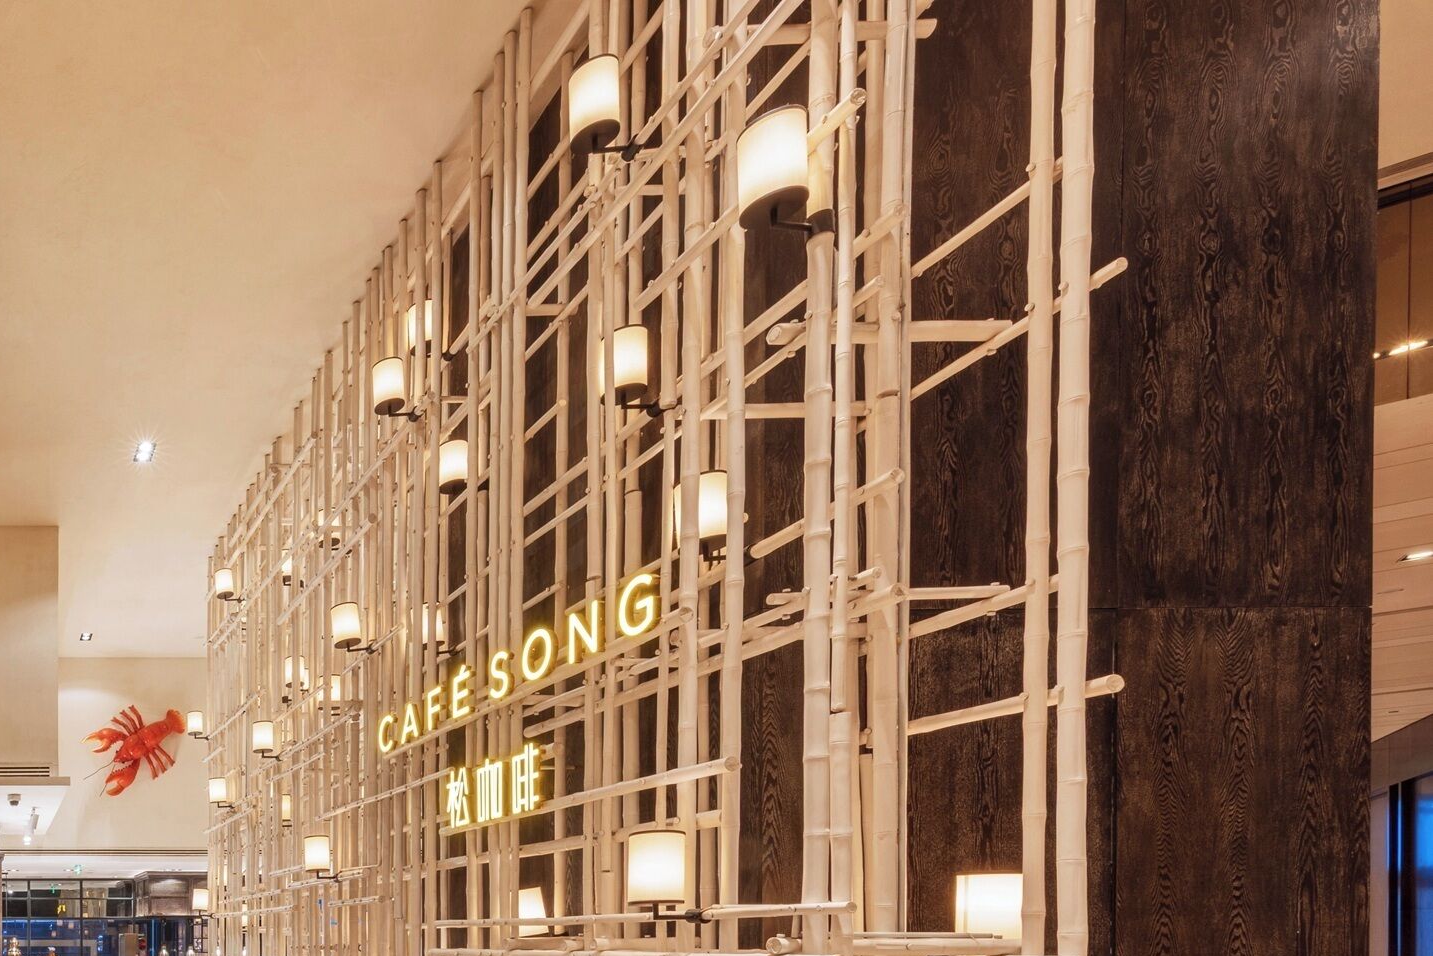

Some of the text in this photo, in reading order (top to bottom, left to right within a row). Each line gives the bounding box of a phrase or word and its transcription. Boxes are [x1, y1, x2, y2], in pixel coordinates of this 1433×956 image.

[378, 573, 655, 752] CAFÉ SONG
[446, 742, 540, 829] 松咖啡
